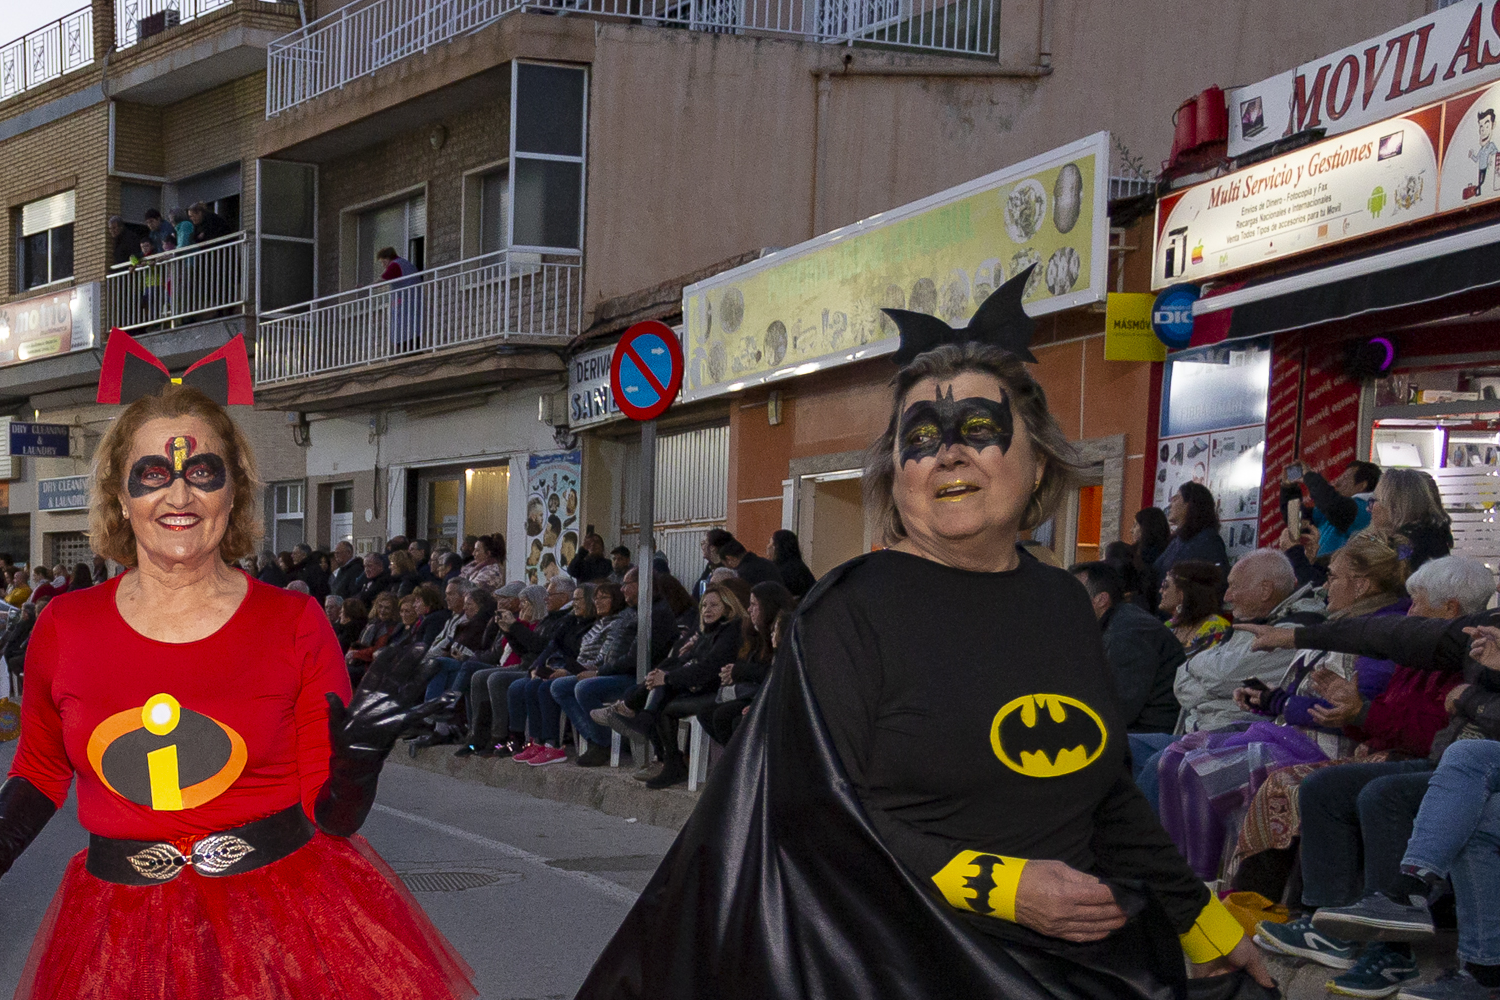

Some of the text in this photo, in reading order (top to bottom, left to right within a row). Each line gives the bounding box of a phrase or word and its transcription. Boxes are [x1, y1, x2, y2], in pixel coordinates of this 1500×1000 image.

[1282, 22, 1438, 137] MOVIL
[1207, 141, 1373, 210] Multi Servicio y Gestiones
[1259, 201, 1265, 211] de
[1266, 197, 1282, 209] Dinero
[1287, 188, 1312, 202] Fotocopia
[1318, 182, 1328, 193] Fax
[1236, 215, 1258, 230] Recargas
[1260, 208, 1286, 221] Nacionales
[1292, 194, 1332, 213] Internacionales
[1226, 232, 1239, 244] Venta
[1241, 228, 1255, 240] Todos
[1257, 224, 1269, 237] Tipos
[1270, 222, 1277, 231] de
[1278, 215, 1306, 229] accesorios
[1307, 211, 1319, 223] para
[11, 424, 67, 435] DRY CLEANING
[22, 446, 57, 456] LAUNDRY
[36, 436, 43, 445] &
[43, 481, 56, 493] DRY
[55, 494, 86, 508] LAUNDRY
